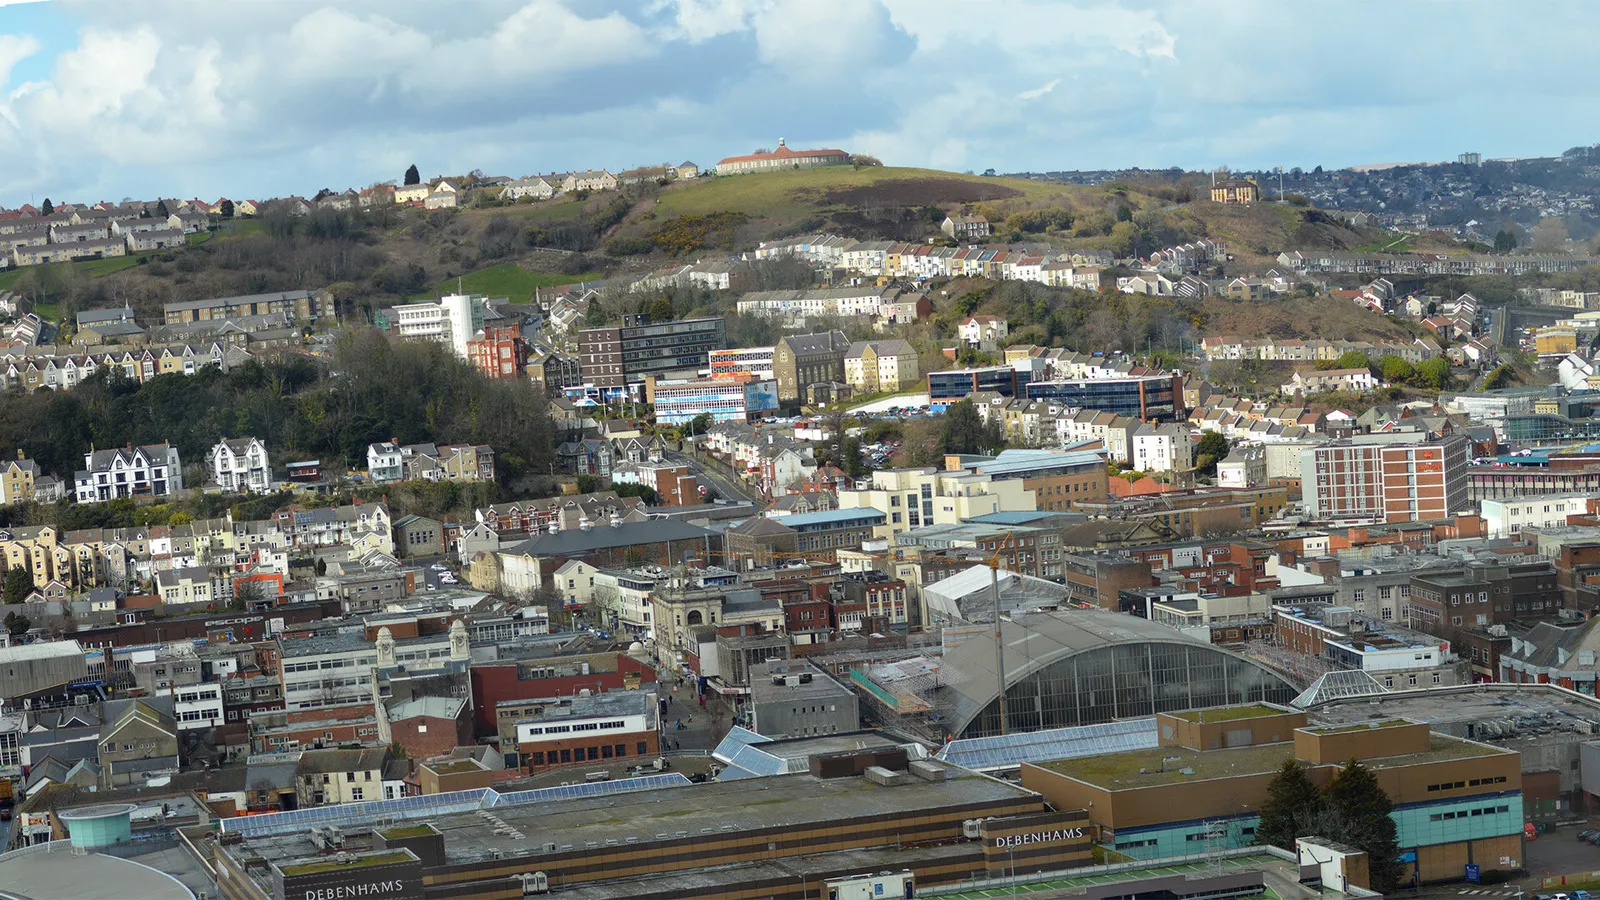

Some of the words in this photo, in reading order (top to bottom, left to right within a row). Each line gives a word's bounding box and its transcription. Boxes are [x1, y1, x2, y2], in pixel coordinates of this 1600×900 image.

[205, 616, 264, 626] escape
[996, 827, 1084, 848] DEBENHAMS
[305, 880, 403, 900] DEBENHAMS
